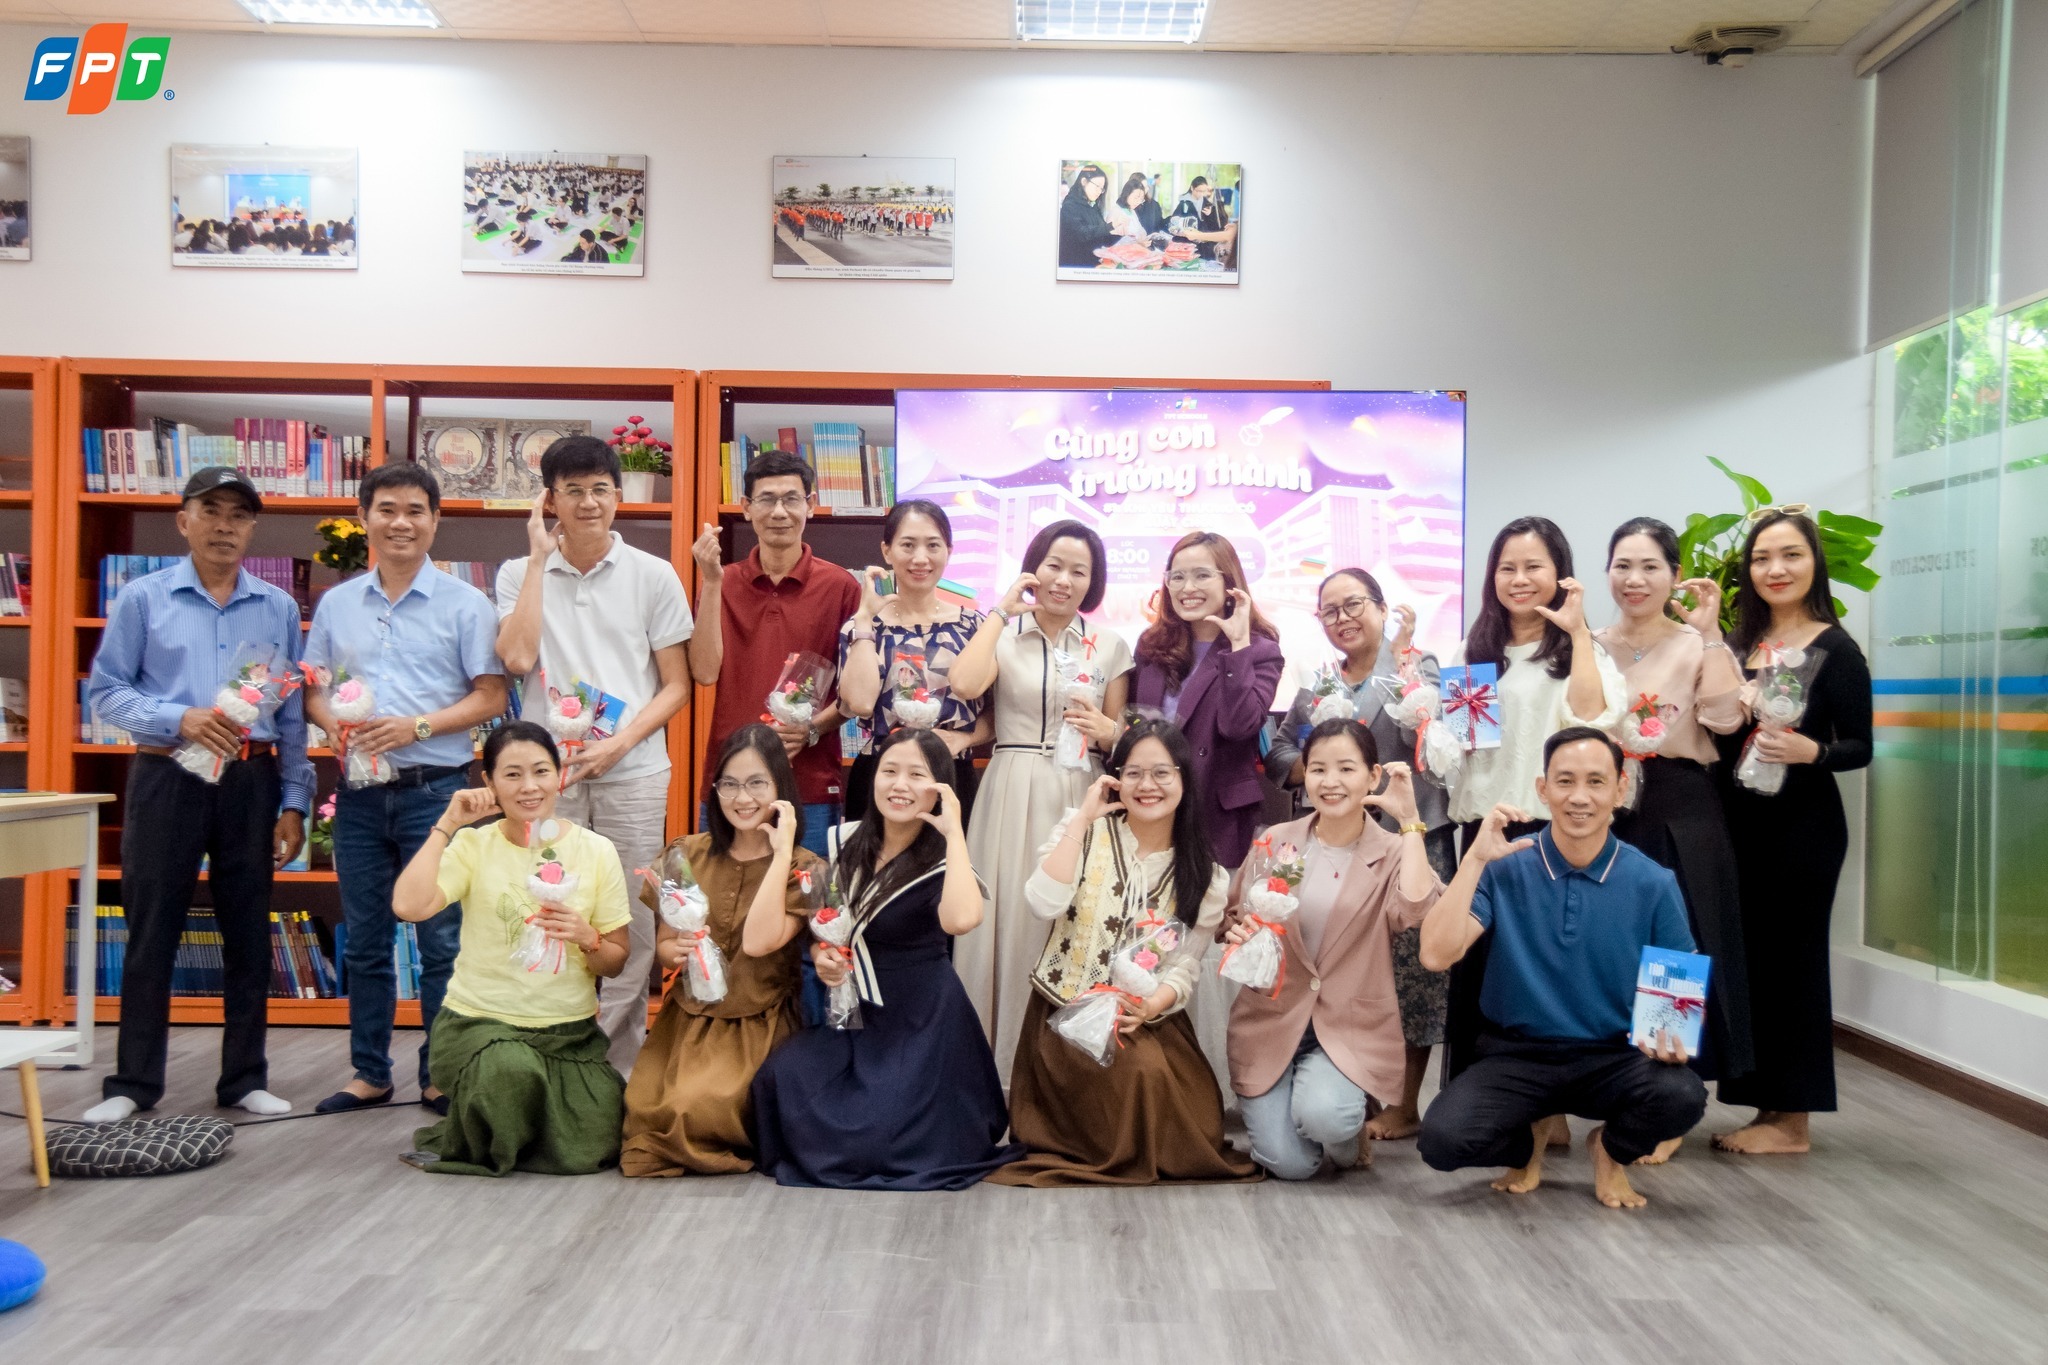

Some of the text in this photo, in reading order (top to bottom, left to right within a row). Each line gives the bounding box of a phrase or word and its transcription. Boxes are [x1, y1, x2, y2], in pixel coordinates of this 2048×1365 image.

[1044, 423, 1216, 464] Cùng con
[1068, 453, 1312, 497] trưởng thành
